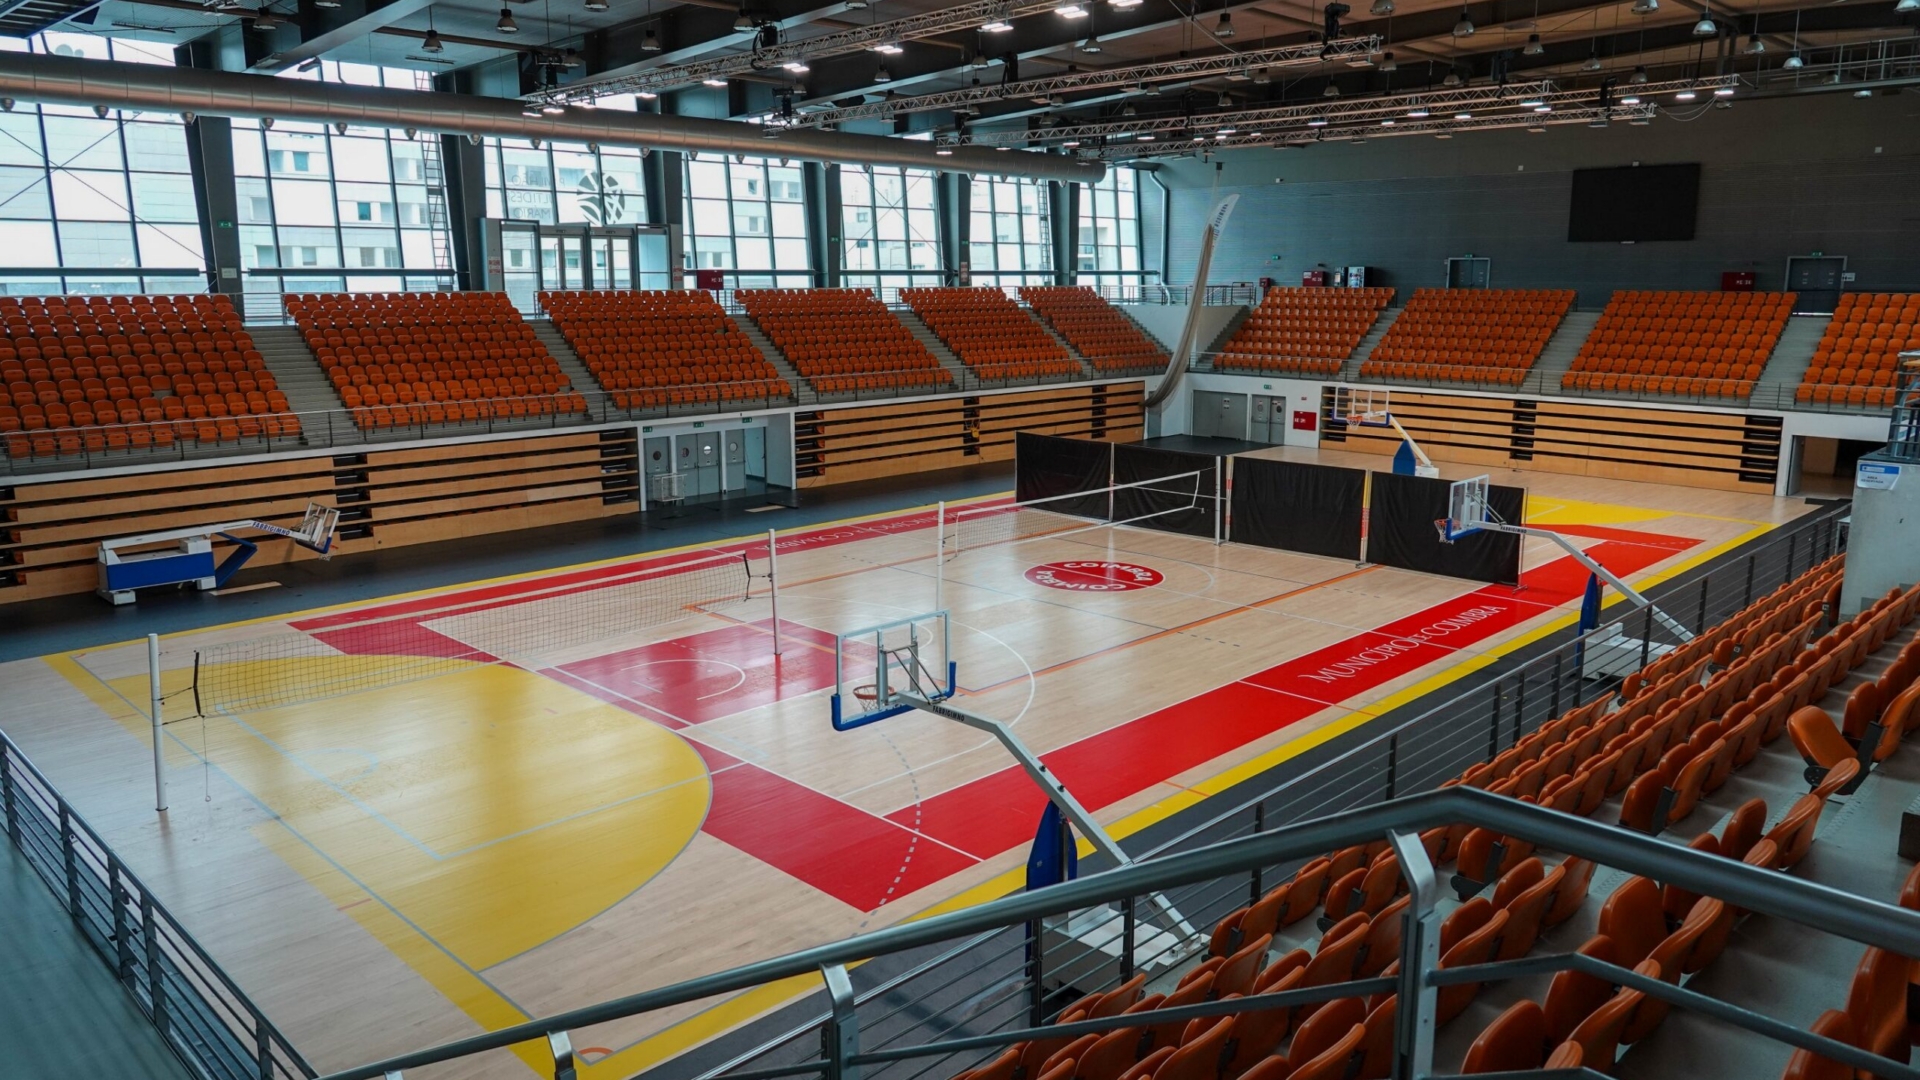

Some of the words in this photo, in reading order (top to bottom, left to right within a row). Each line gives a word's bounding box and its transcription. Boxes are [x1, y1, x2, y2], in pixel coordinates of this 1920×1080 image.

[252, 521, 291, 536] FABRIGIMNO
[1036, 570, 1127, 590] COIMBRA
[1063, 562, 1154, 581] COIMBRA
[1297, 638, 1420, 684] MUNICÍPIO
[1421, 605, 1508, 637] COIMBRA
[932, 705, 965, 722] FABRIGIMNO
